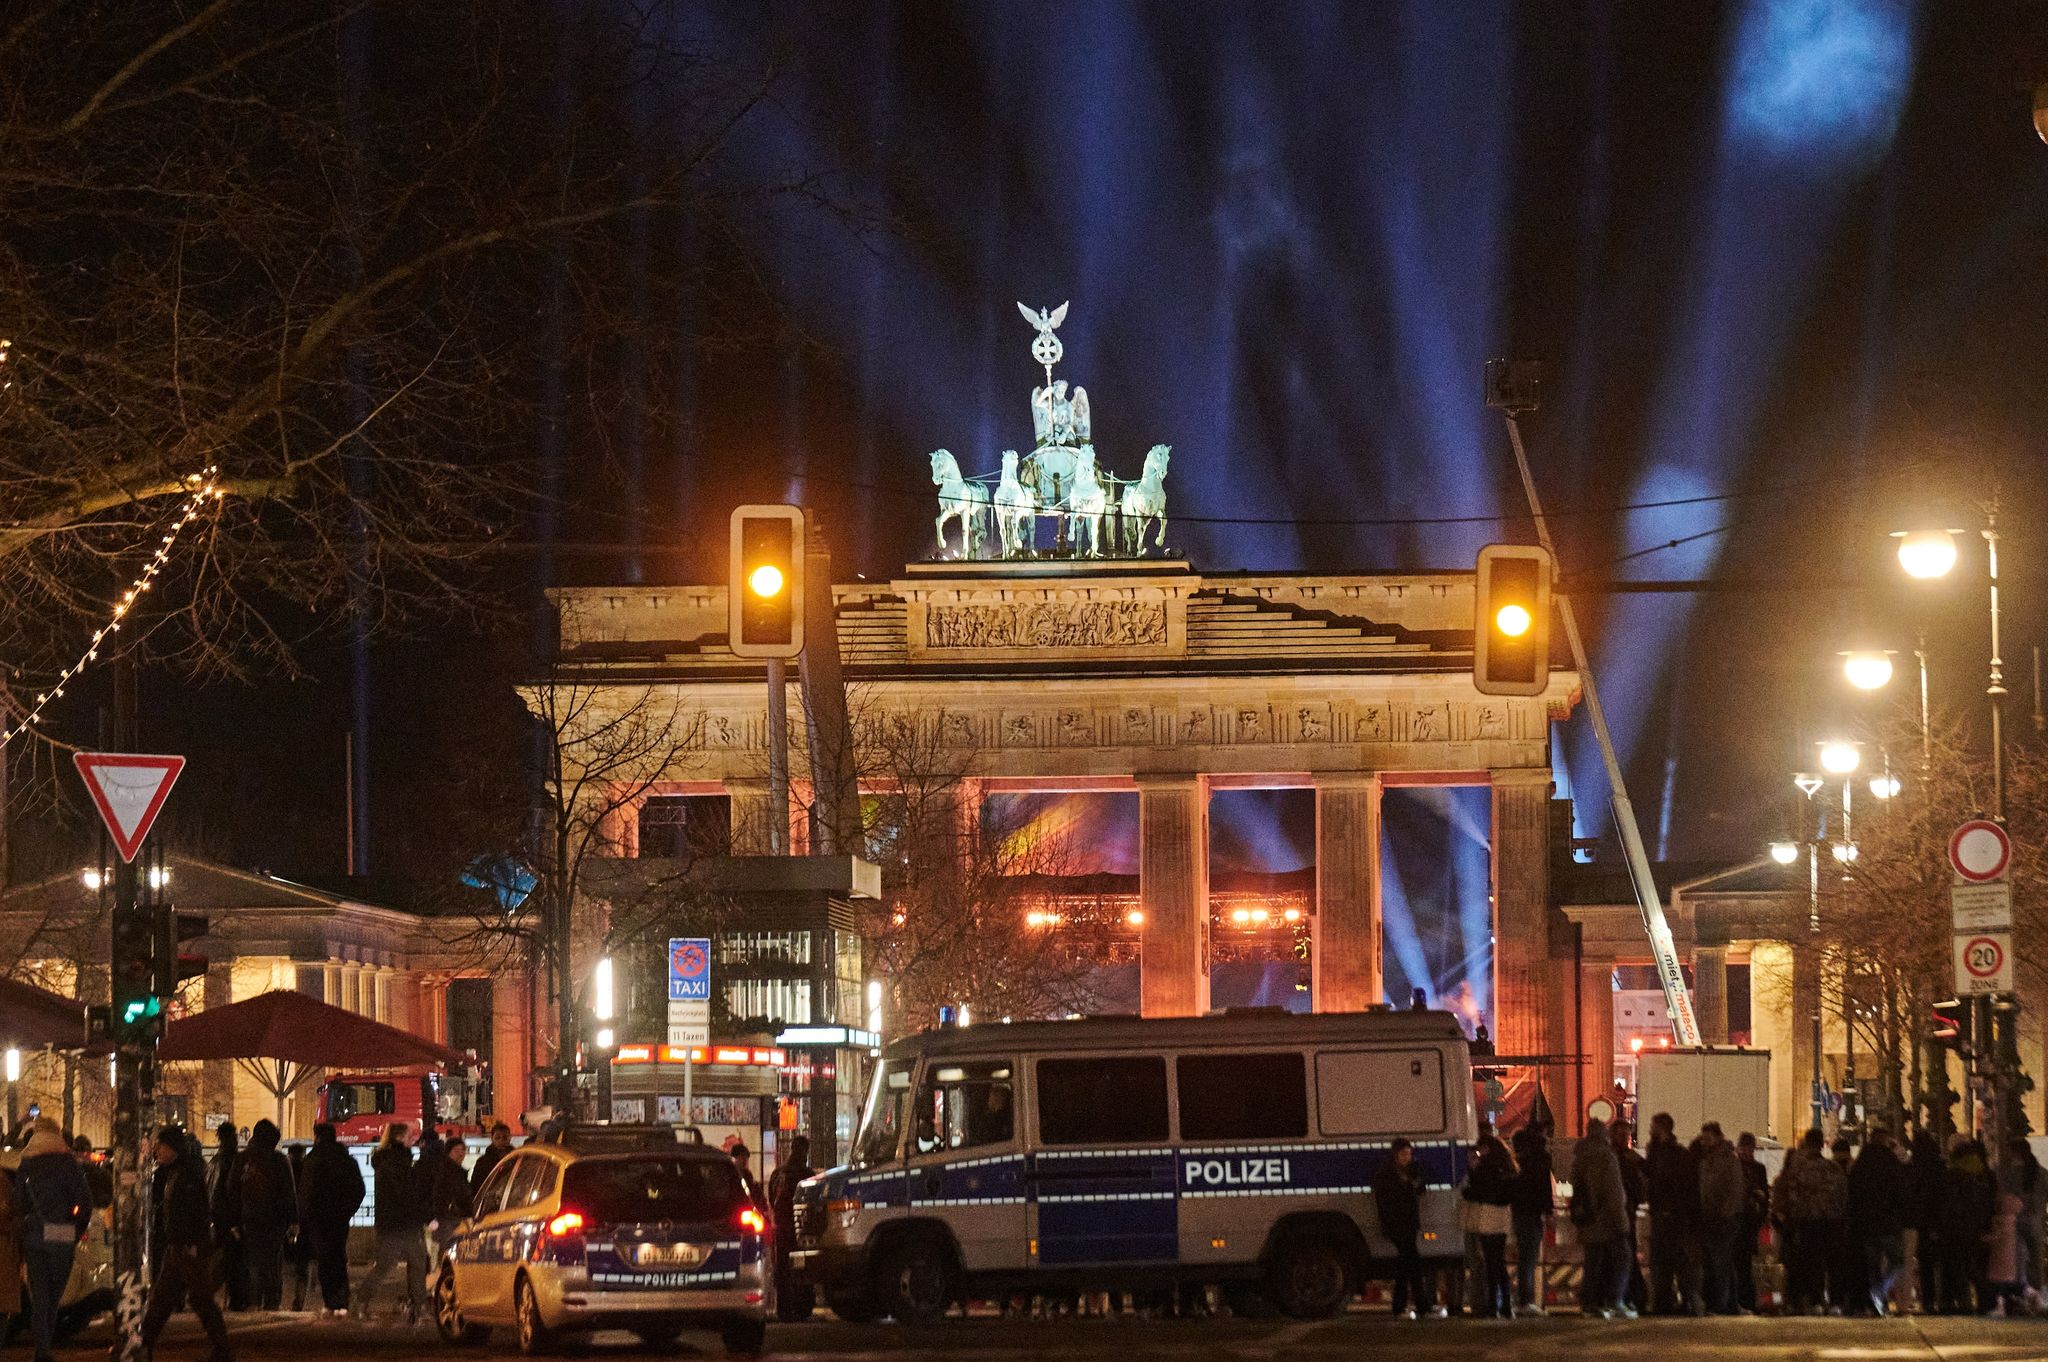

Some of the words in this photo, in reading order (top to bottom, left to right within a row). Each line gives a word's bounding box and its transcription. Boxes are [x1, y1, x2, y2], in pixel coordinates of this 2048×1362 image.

[1972, 948, 1996, 967] 20
[673, 981, 706, 995] TAXI
[1970, 979, 1999, 990] ZONE
[1675, 993, 1696, 1040] mateco
[673, 1032, 680, 1040] 11
[683, 1031, 705, 1041] Taxen
[1186, 1159, 1290, 1185] POLIZEI
[644, 1273, 689, 1287] POLIZEI
